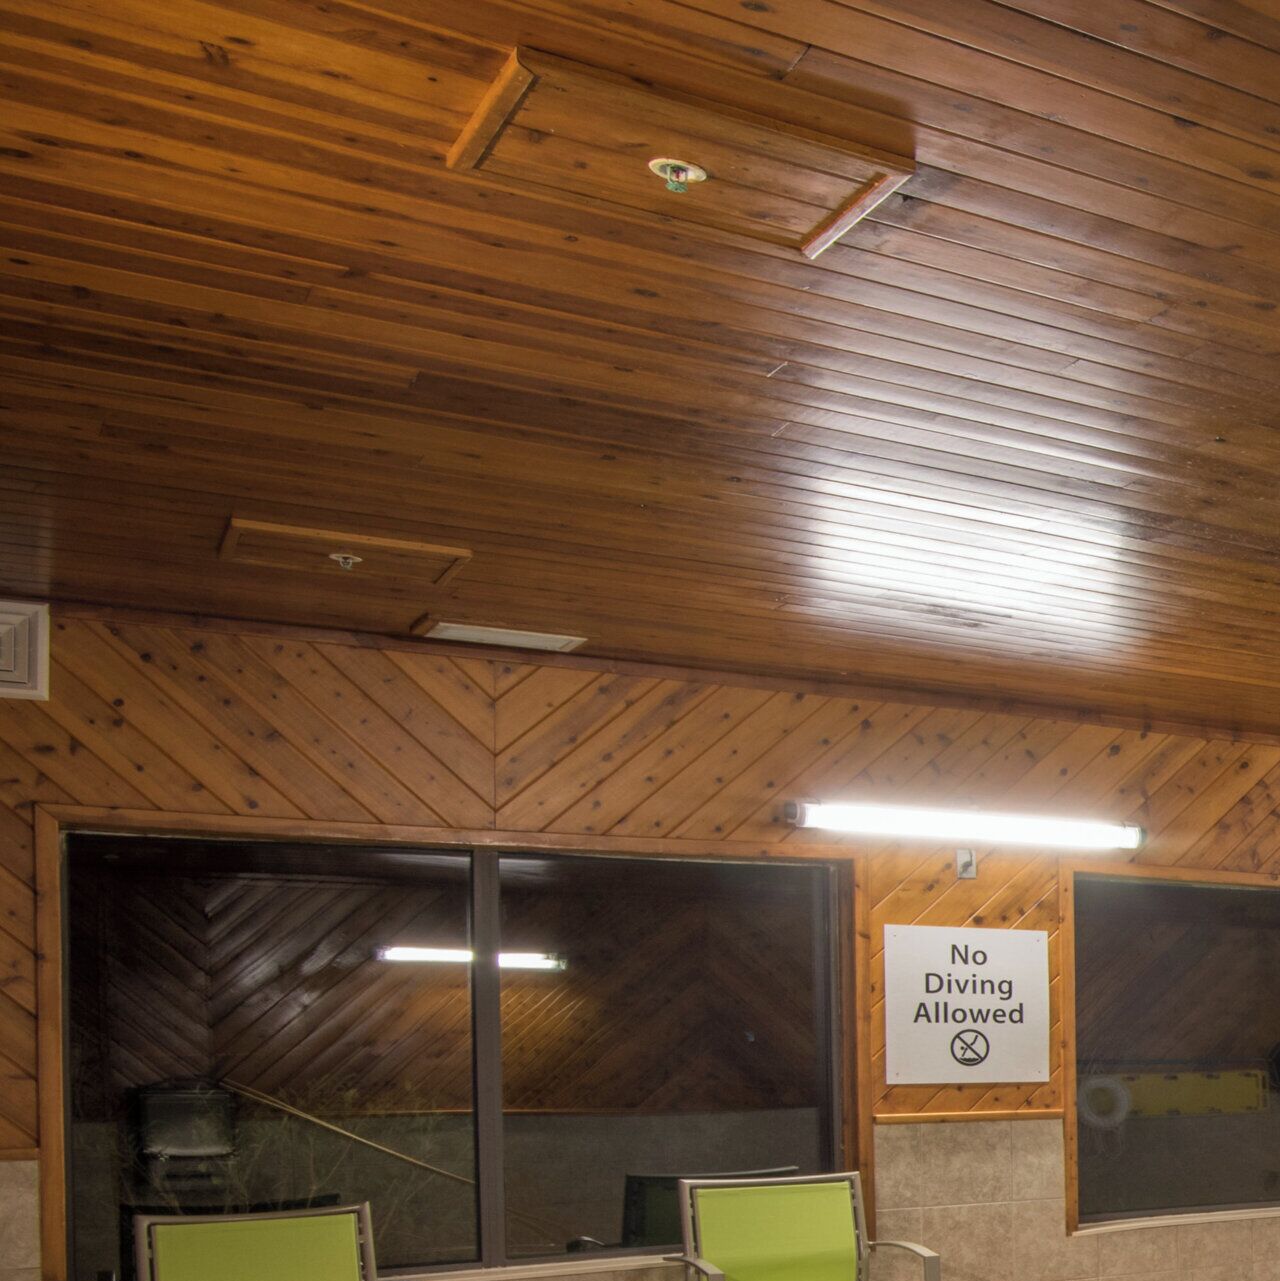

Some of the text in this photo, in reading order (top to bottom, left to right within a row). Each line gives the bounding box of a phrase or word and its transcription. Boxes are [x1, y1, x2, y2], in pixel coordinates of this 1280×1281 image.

[951, 944, 988, 966] No
[925, 972, 1013, 1001] Diving
[913, 1001, 1024, 1024] Allowed
